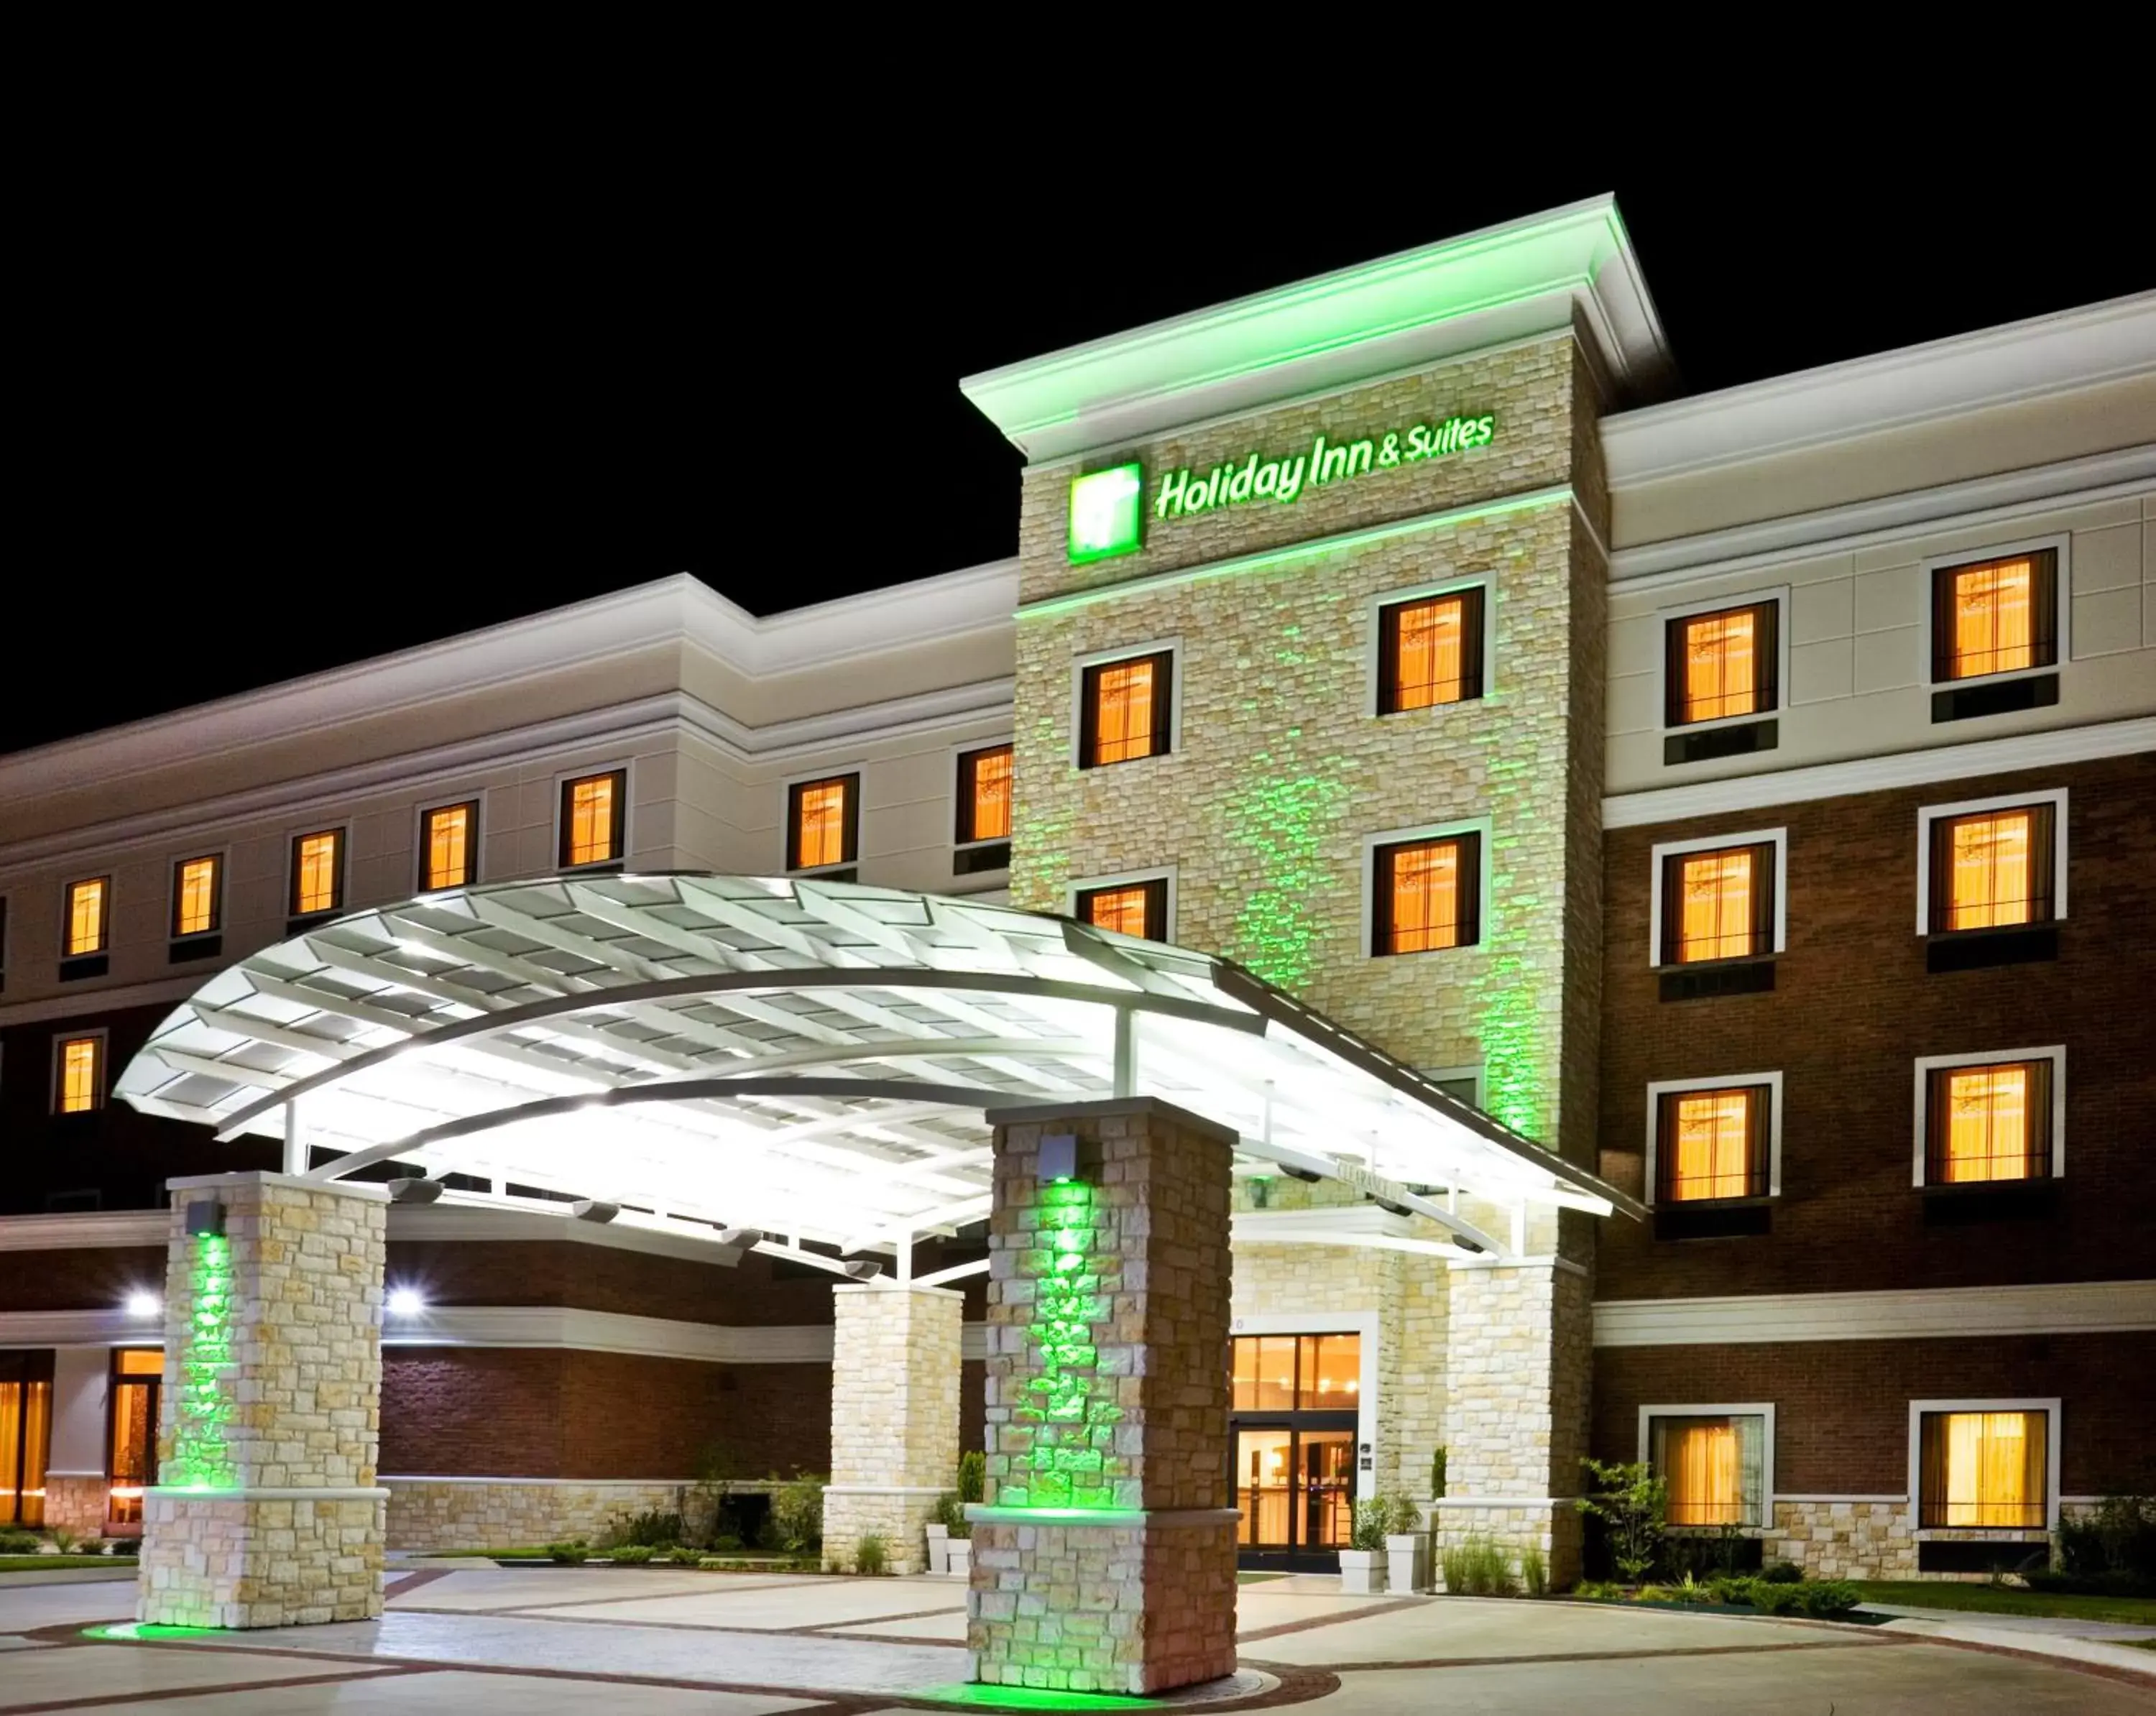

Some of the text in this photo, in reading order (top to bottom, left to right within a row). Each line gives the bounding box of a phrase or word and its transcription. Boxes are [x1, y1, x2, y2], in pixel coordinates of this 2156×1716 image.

[1155, 416, 1494, 518] Holiday Inn & Suites
